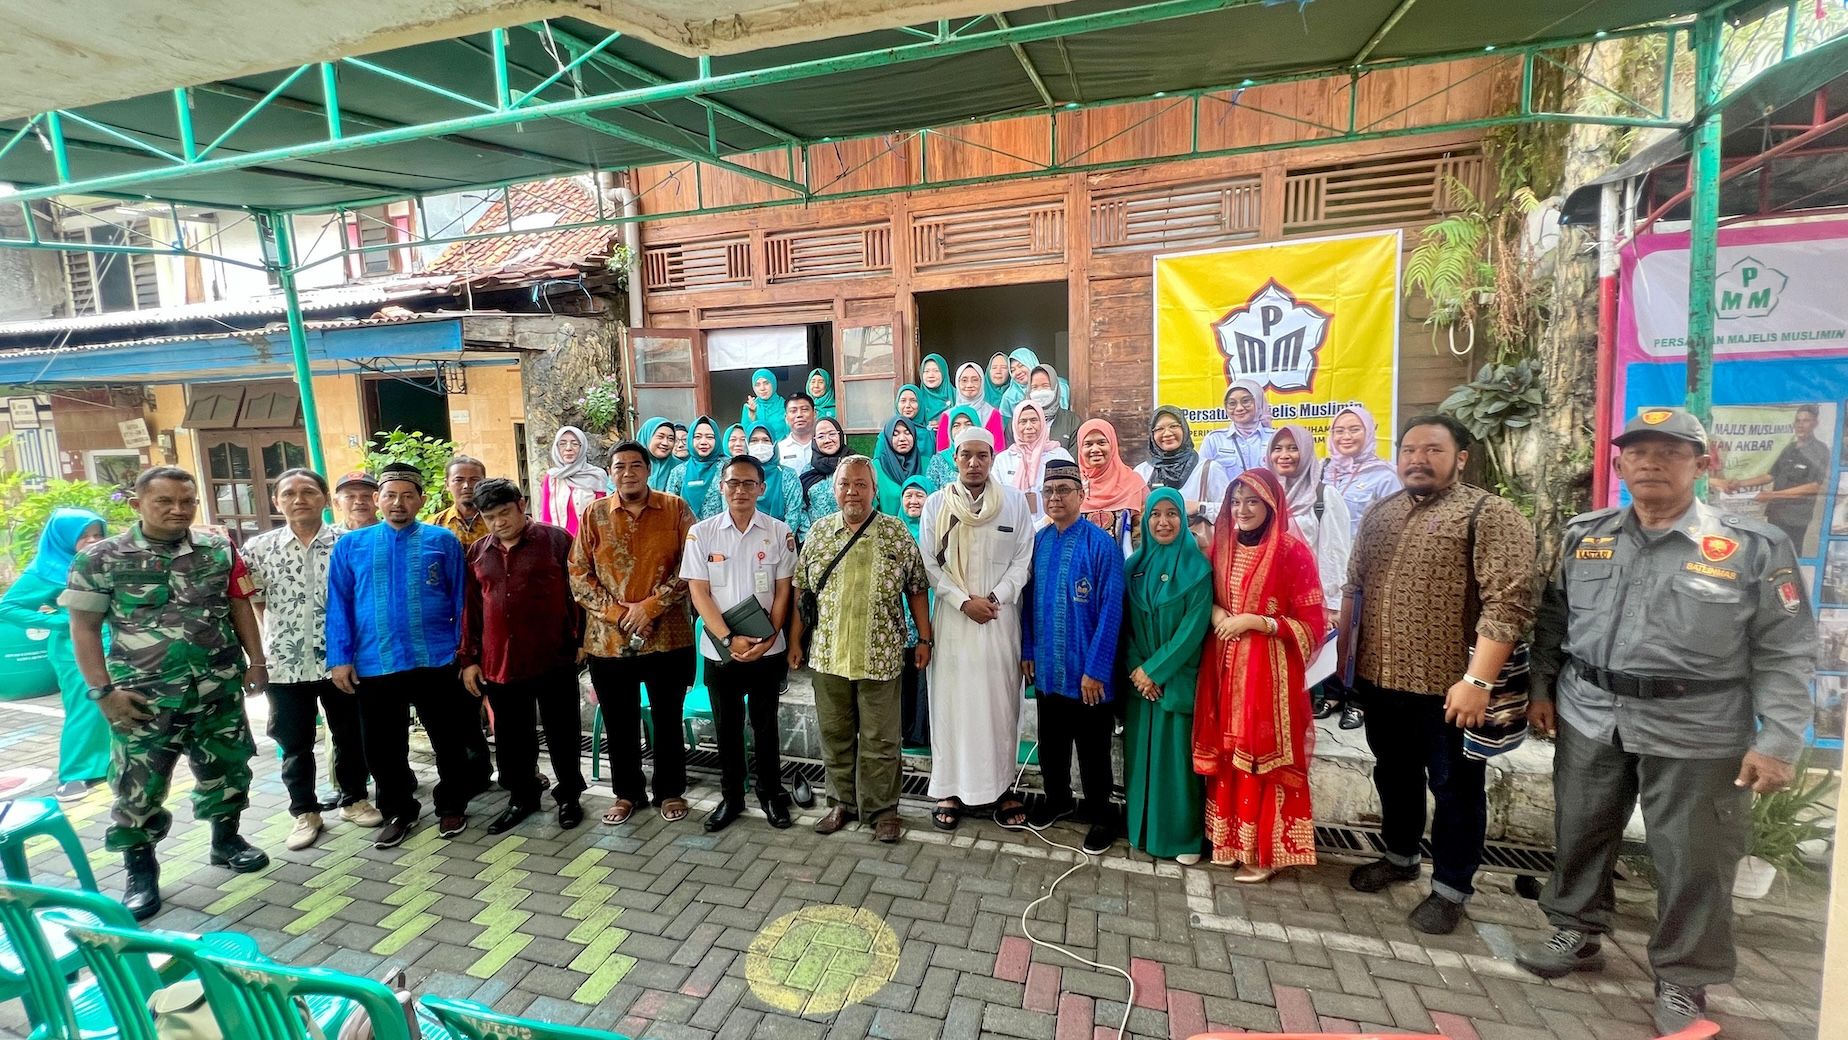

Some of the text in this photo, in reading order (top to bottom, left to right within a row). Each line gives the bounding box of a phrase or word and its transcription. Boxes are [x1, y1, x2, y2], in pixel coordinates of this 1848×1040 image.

[1742, 267, 1758, 288] P
[1261, 305, 1283, 336] P
[1654, 329, 1846, 348] PERSAN MAJELIS MUSLIMIN
[1183, 408, 1229, 422] Persatu
[1735, 439, 1775, 452] AKBAR
